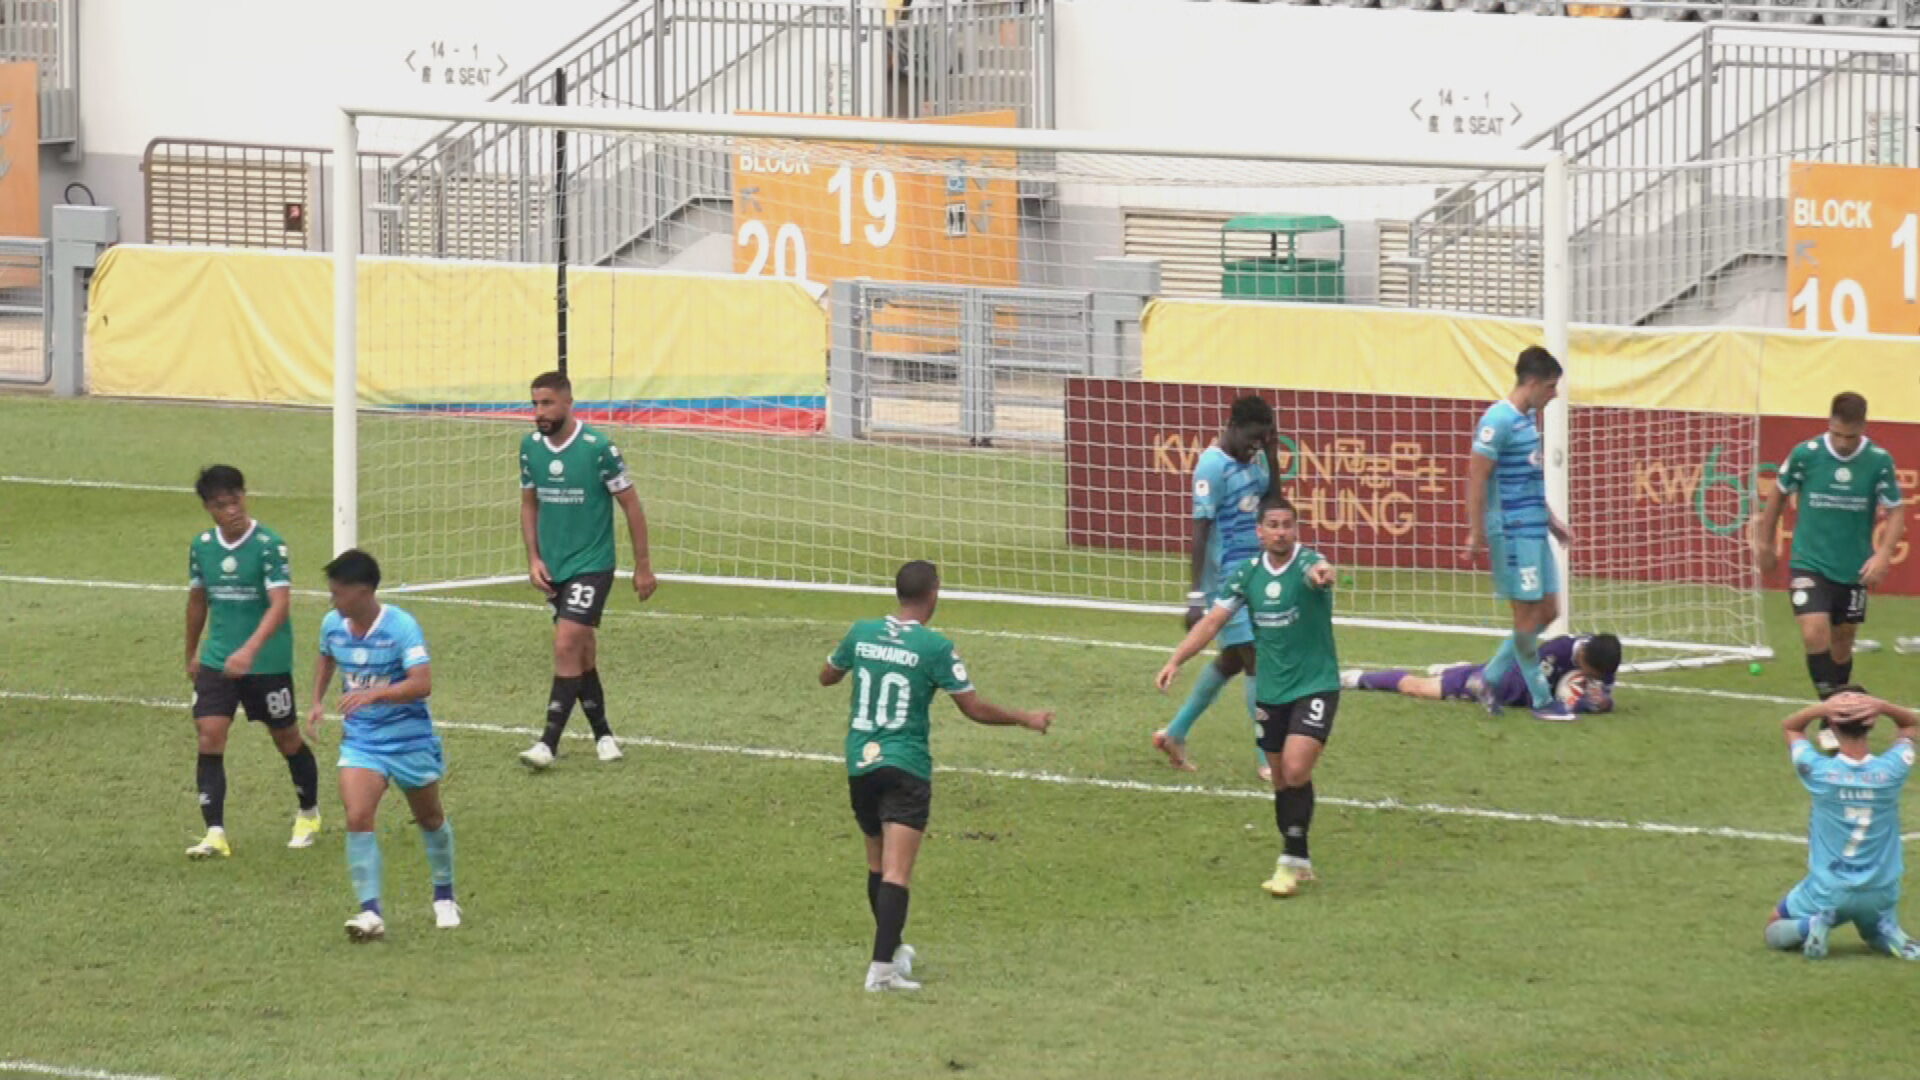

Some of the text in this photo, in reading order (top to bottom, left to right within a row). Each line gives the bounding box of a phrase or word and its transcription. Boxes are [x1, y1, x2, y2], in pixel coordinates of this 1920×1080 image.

[431, 41, 445, 58] 14
[459, 67, 490, 85] SEAT
[1438, 88, 1453, 106] 14
[1469, 115, 1505, 136] SEAT
[739, 150, 810, 174] BLOCK
[828, 160, 897, 248] 19
[1794, 198, 1873, 228] BLOCK
[738, 219, 808, 278] 20
[567, 583, 595, 609] 33
[855, 641, 919, 668] FERNANDO
[266, 687, 292, 719] 80
[851, 667, 911, 731] 10
[1309, 698, 1325, 720] 9
[1843, 806, 1873, 857] 7
